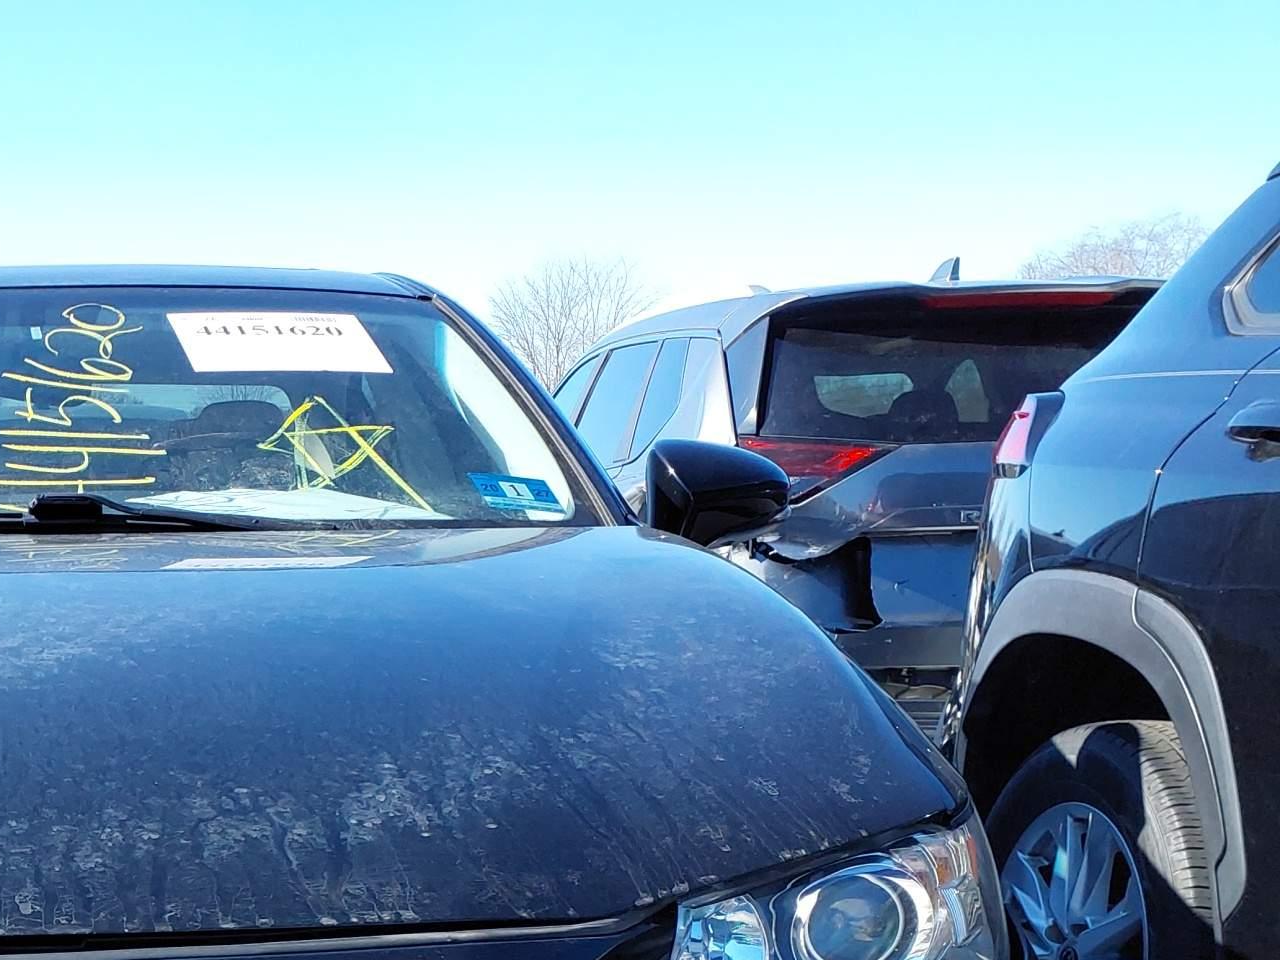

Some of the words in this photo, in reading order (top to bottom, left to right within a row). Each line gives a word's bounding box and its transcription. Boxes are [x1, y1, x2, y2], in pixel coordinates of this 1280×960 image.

[196, 325, 344, 336] 44151620
[481, 483, 499, 492] 20
[508, 484, 525, 497] 1
[533, 488, 550, 498] 27
